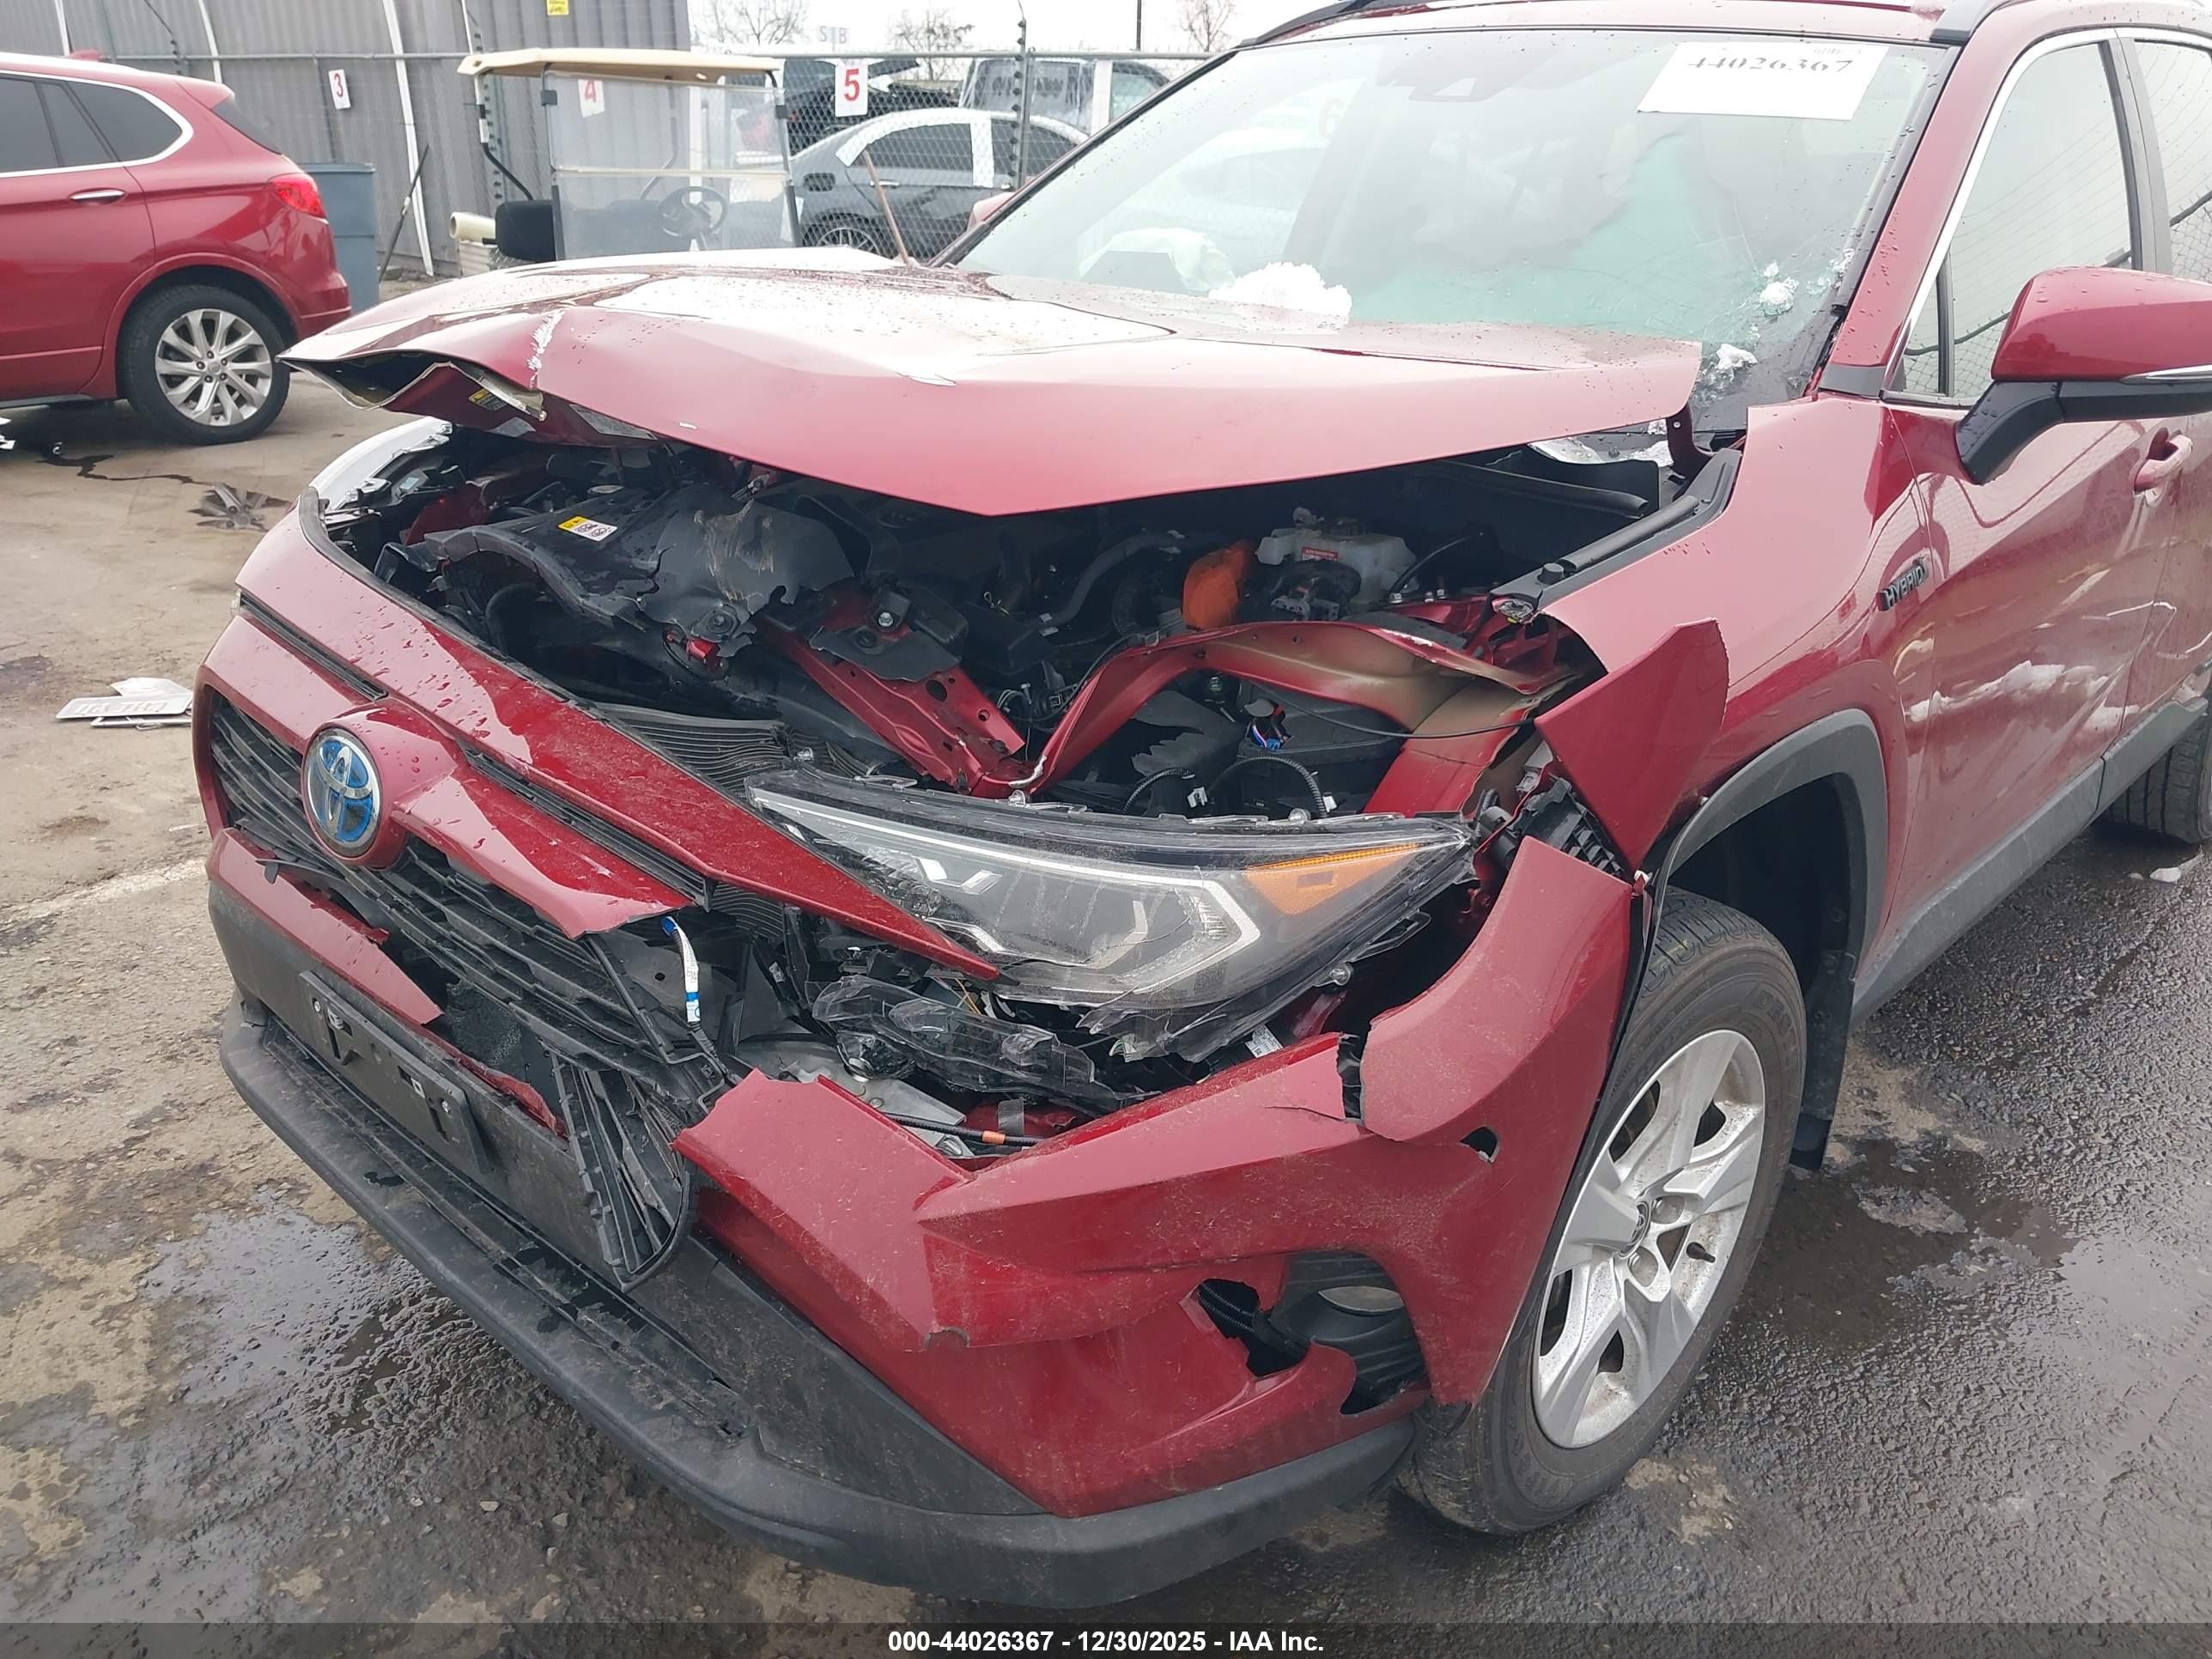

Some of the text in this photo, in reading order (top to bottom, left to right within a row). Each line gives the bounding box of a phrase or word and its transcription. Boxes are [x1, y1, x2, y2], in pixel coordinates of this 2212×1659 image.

[1687, 57, 1854, 72] 44026367
[334, 72, 343, 98] 3
[584, 80, 596, 103] 4
[844, 69, 860, 101] 5
[1884, 566, 1925, 611] HYBRID
